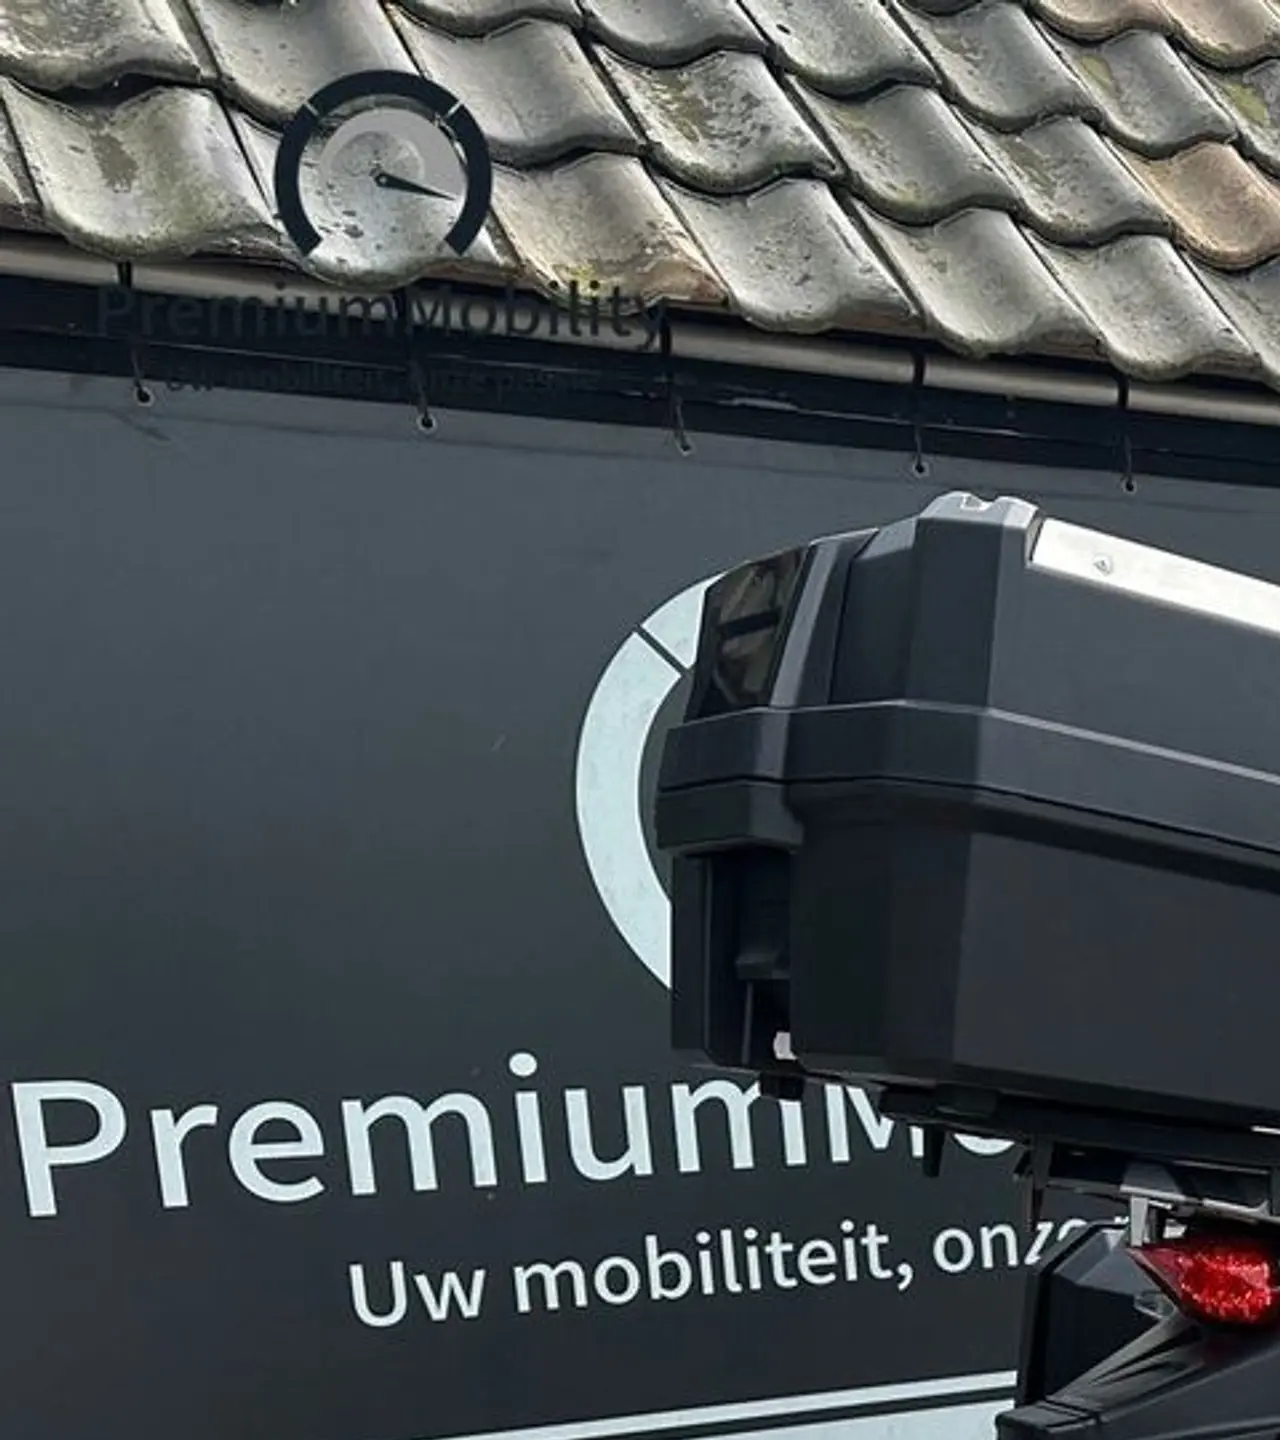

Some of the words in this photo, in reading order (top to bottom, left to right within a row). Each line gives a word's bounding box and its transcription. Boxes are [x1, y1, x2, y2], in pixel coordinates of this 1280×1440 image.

[349, 1259, 486, 1327] Uw
[513, 1219, 913, 1314] mobiliteit,
[933, 1218, 1087, 1273] onz
